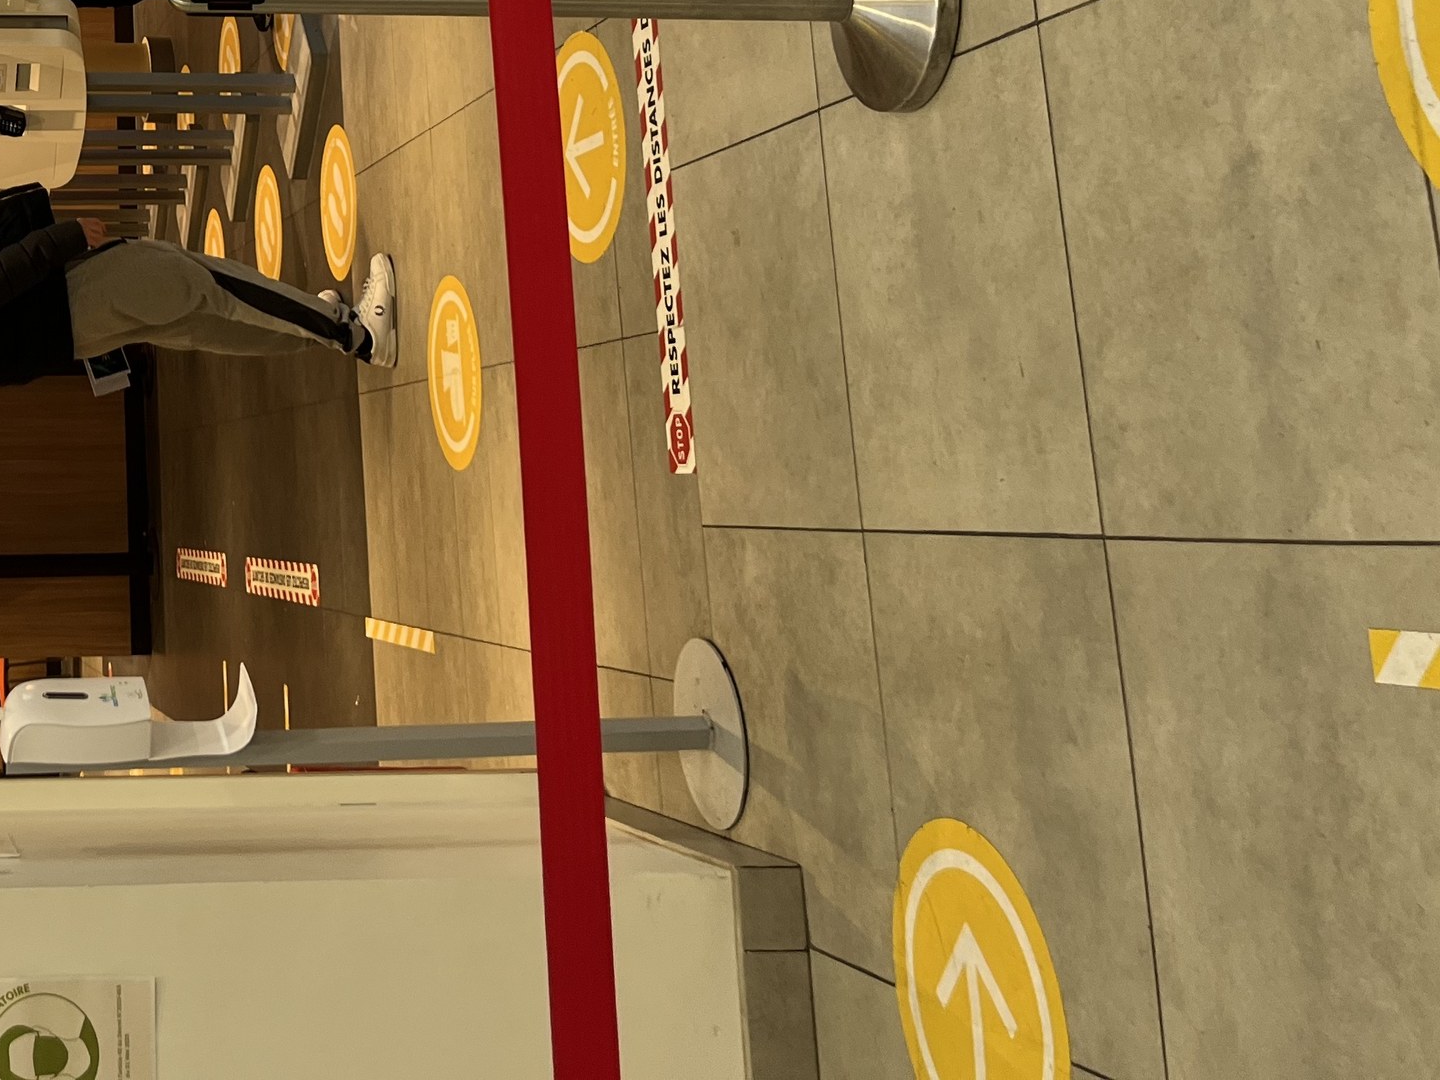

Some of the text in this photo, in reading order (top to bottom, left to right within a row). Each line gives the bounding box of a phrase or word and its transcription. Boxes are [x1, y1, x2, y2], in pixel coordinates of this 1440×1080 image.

[608, 96, 619, 167] ENTRÉE
[642, 38, 662, 185] DISTANCES
[655, 194, 667, 237] LES
[660, 249, 680, 395] RESPECTEZ
[674, 417, 686, 461] STOP
